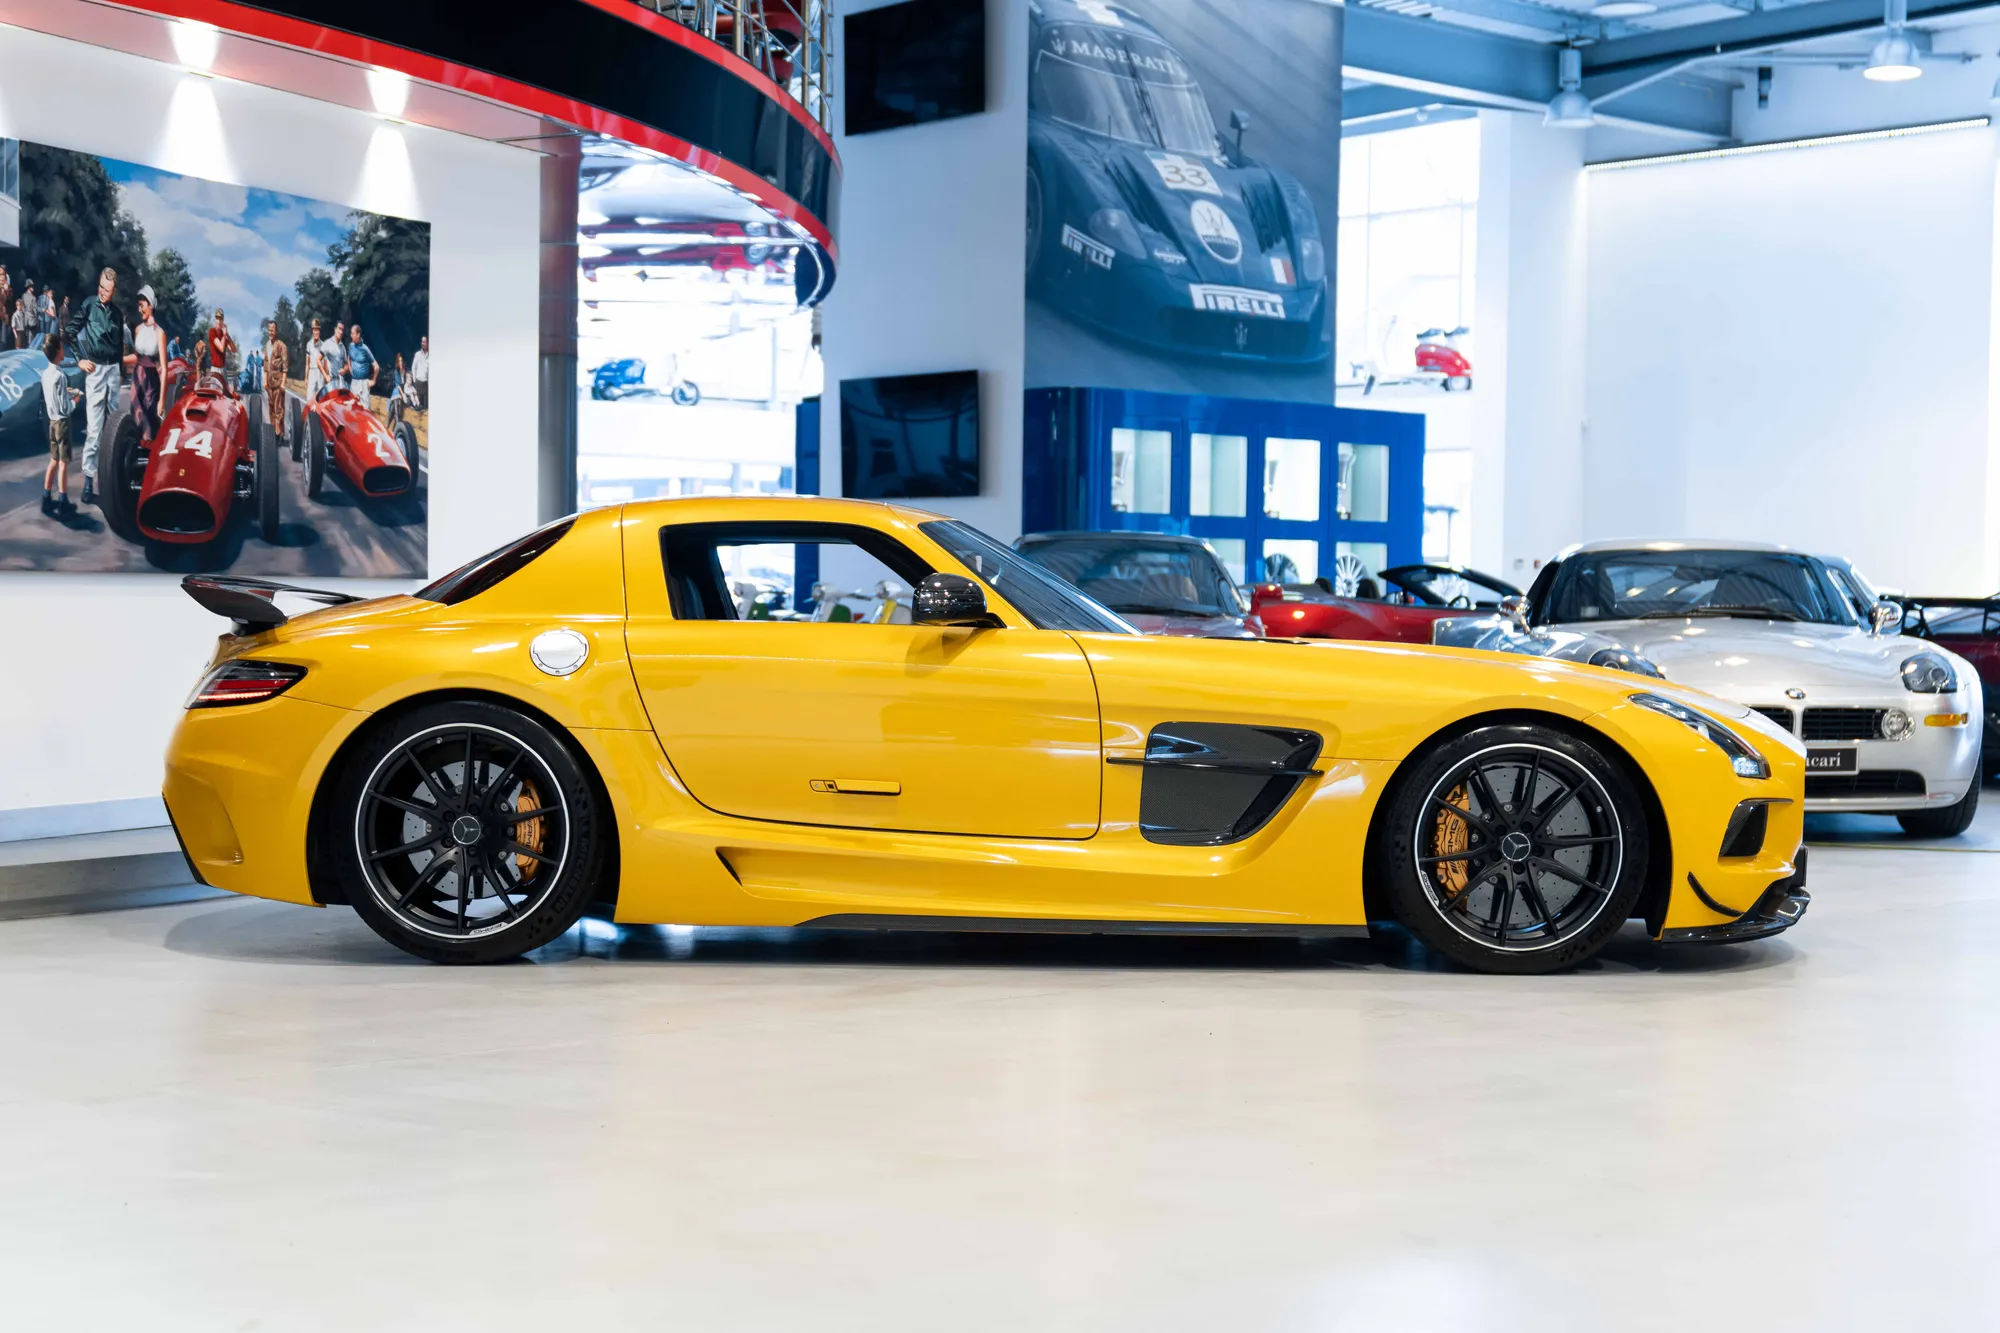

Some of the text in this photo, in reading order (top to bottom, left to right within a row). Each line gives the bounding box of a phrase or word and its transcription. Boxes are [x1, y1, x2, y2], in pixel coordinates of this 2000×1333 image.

[1070, 40, 1176, 75] MASERATI
[1163, 165, 1208, 187] 33
[1189, 283, 1286, 319] PIRELLI
[159, 428, 212, 460] 14
[367, 433, 390, 458] 2
